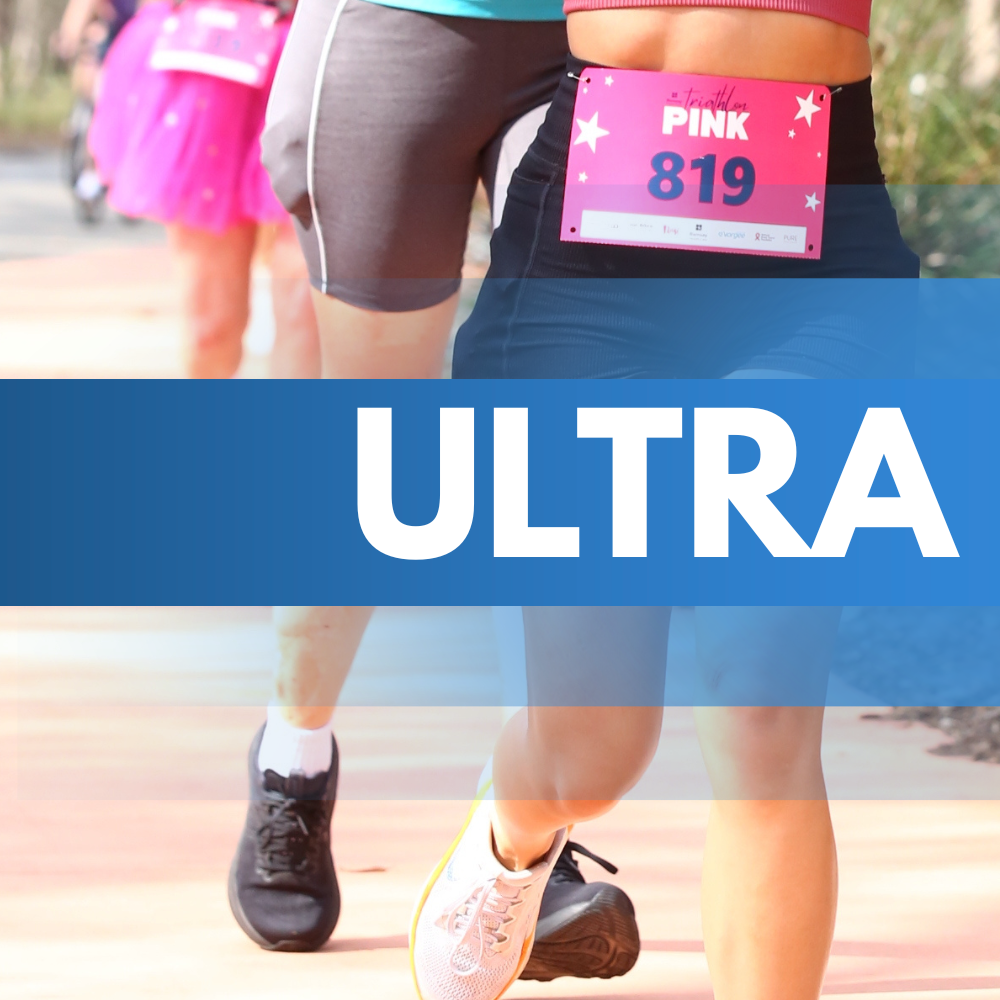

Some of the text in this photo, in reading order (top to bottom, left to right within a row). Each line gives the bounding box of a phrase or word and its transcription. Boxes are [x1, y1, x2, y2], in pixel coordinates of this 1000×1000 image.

[683, 84, 747, 111] triathlon
[662, 105, 750, 140] PINK
[647, 151, 756, 206] 819
